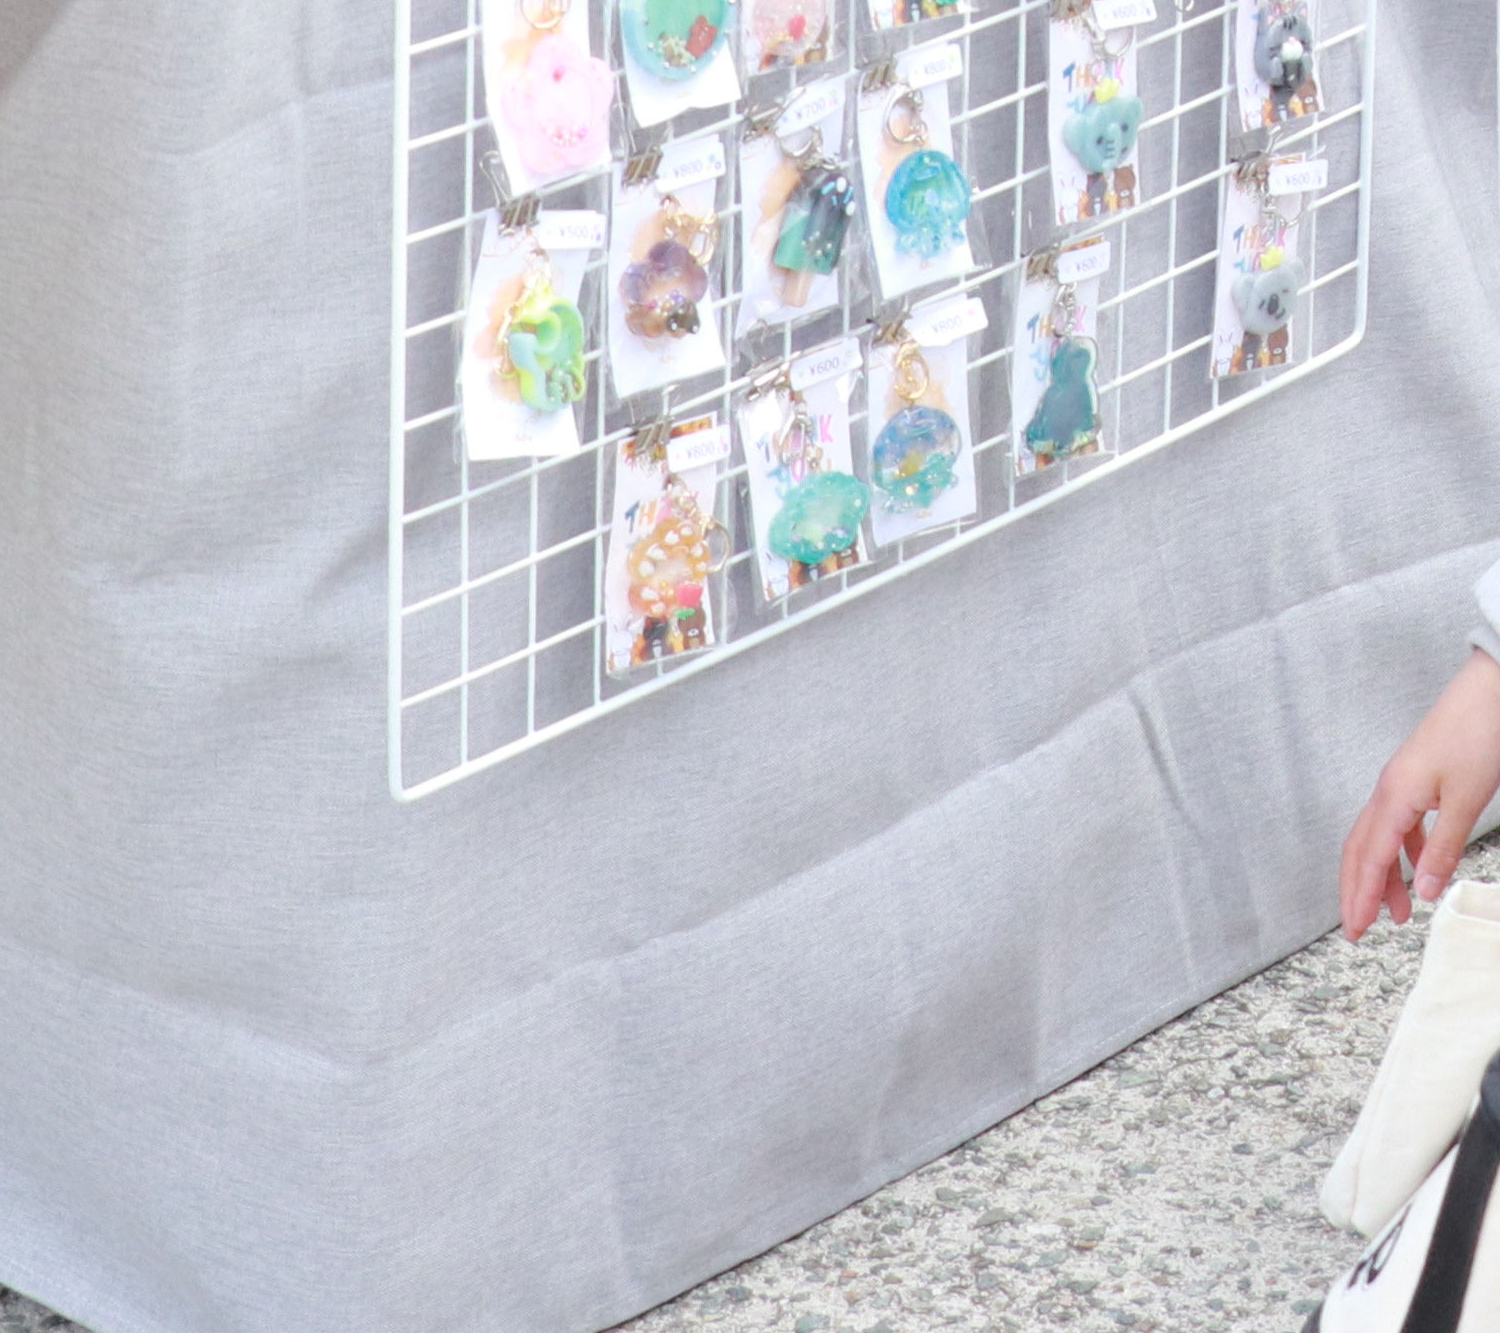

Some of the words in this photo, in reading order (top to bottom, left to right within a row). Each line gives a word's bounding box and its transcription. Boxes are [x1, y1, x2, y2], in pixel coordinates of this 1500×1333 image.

[671, 161, 704, 179] ¥800
[559, 225, 589, 239] ¥500
[808, 357, 841, 377] ¥600
[685, 441, 716, 459] ¥800
